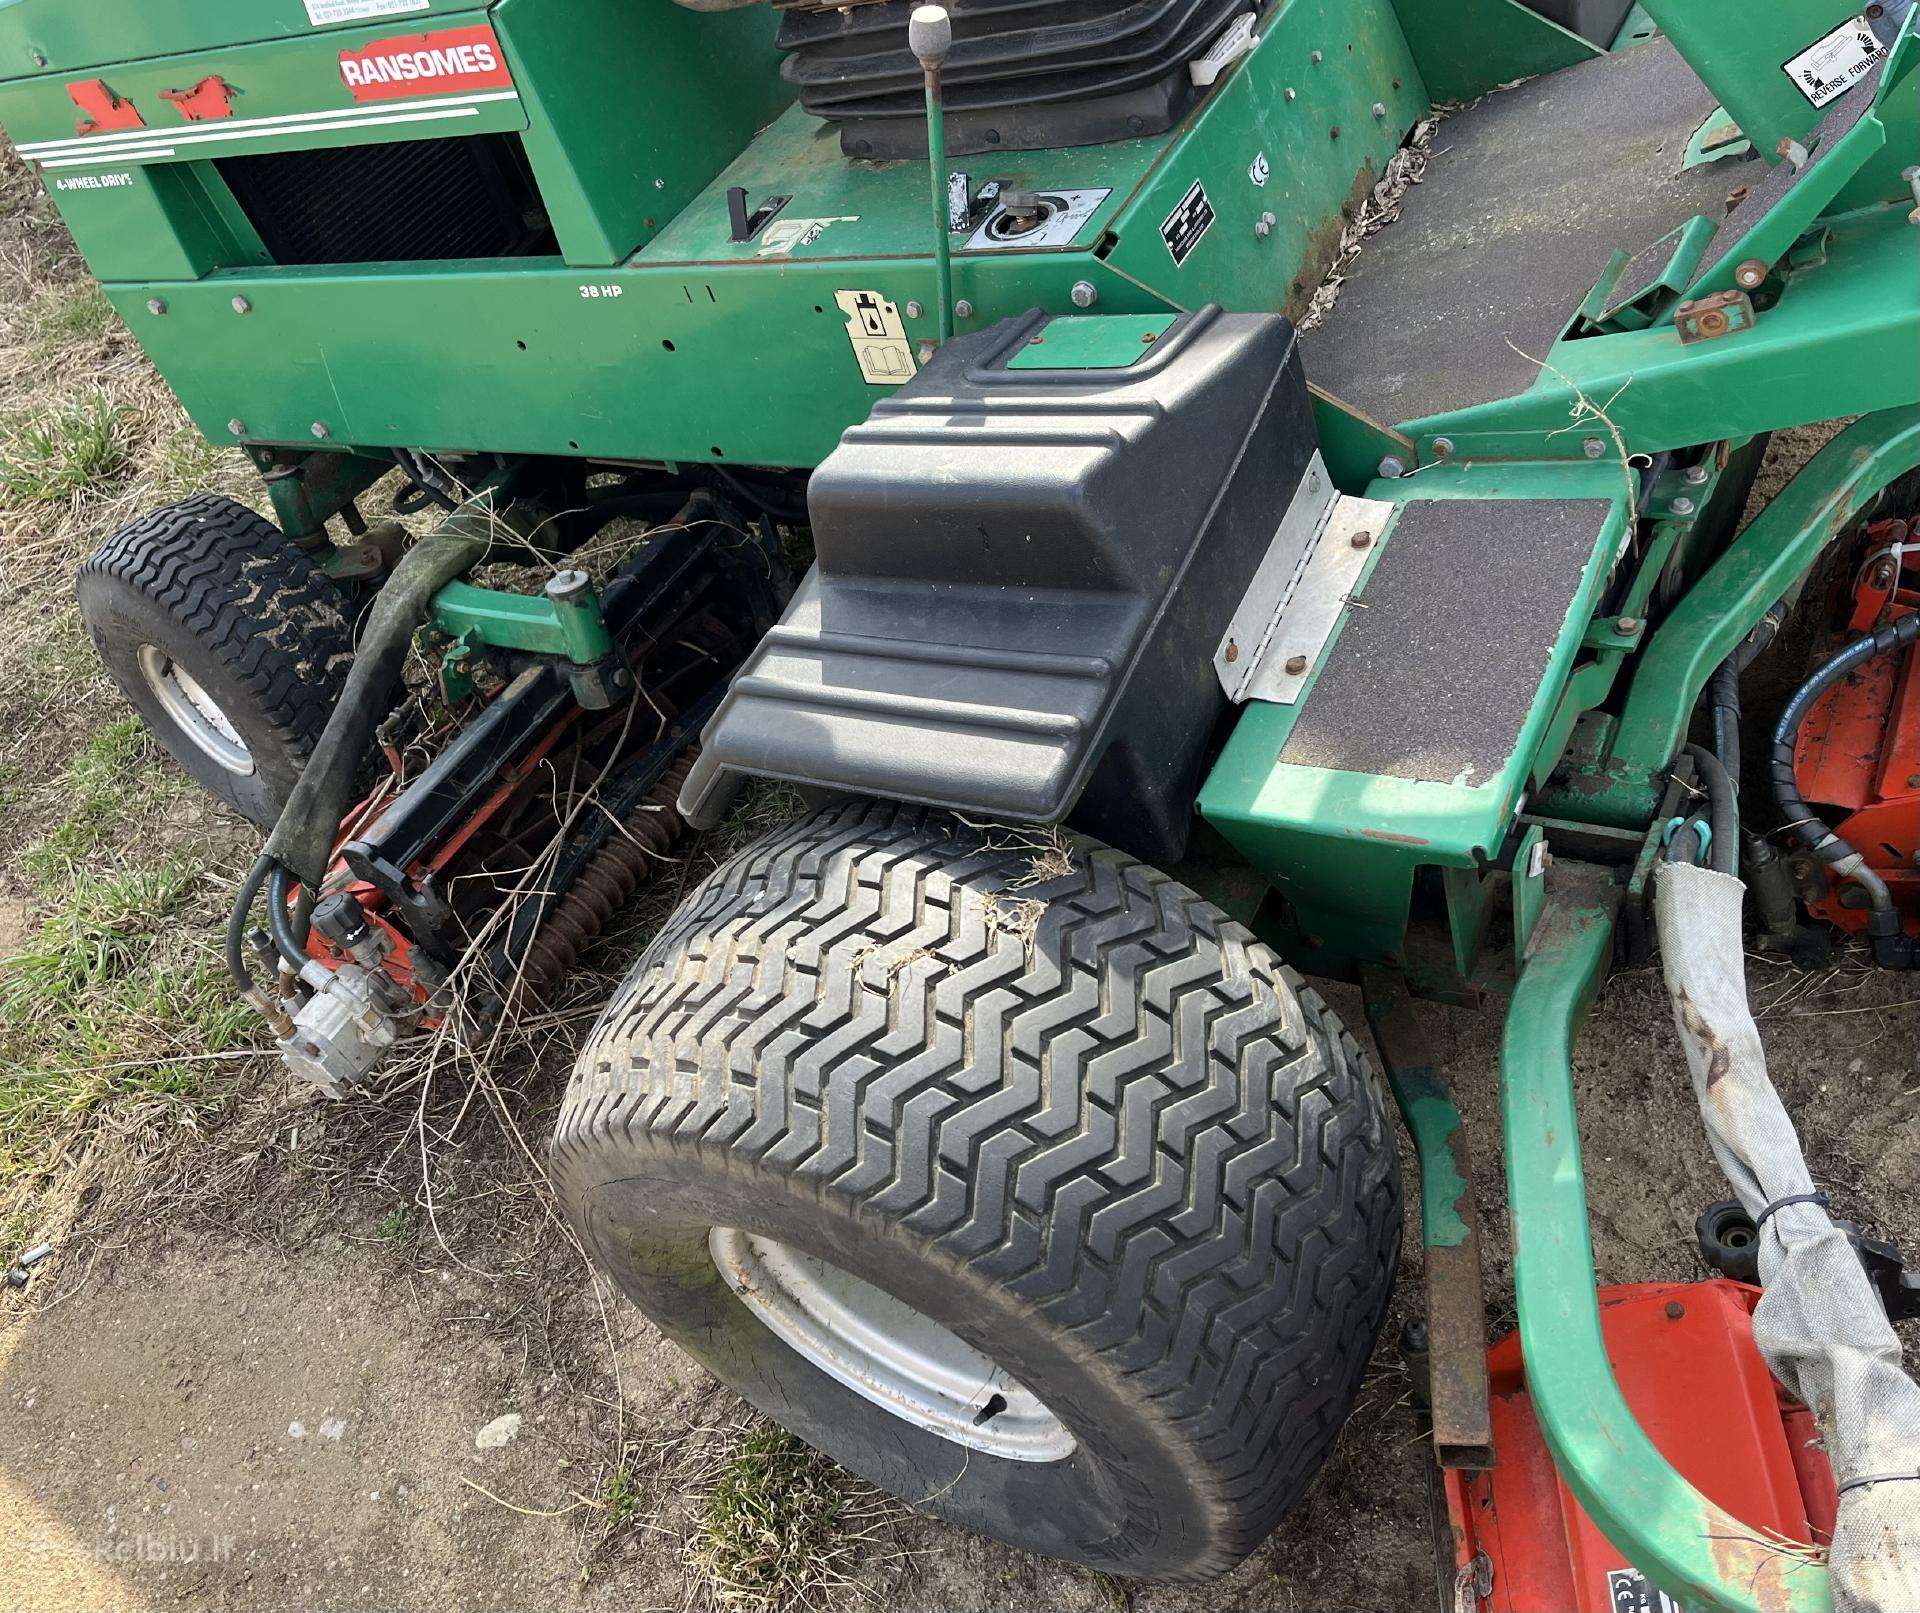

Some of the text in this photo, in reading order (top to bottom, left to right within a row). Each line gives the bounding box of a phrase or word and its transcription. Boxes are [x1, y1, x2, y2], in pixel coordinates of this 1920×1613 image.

[340, 43, 497, 86] RANSOMES
[1810, 46, 1889, 102] REVERSE FORWARD
[56, 175, 102, 190] 4-WHEEL
[579, 285, 623, 298] 38 HP
